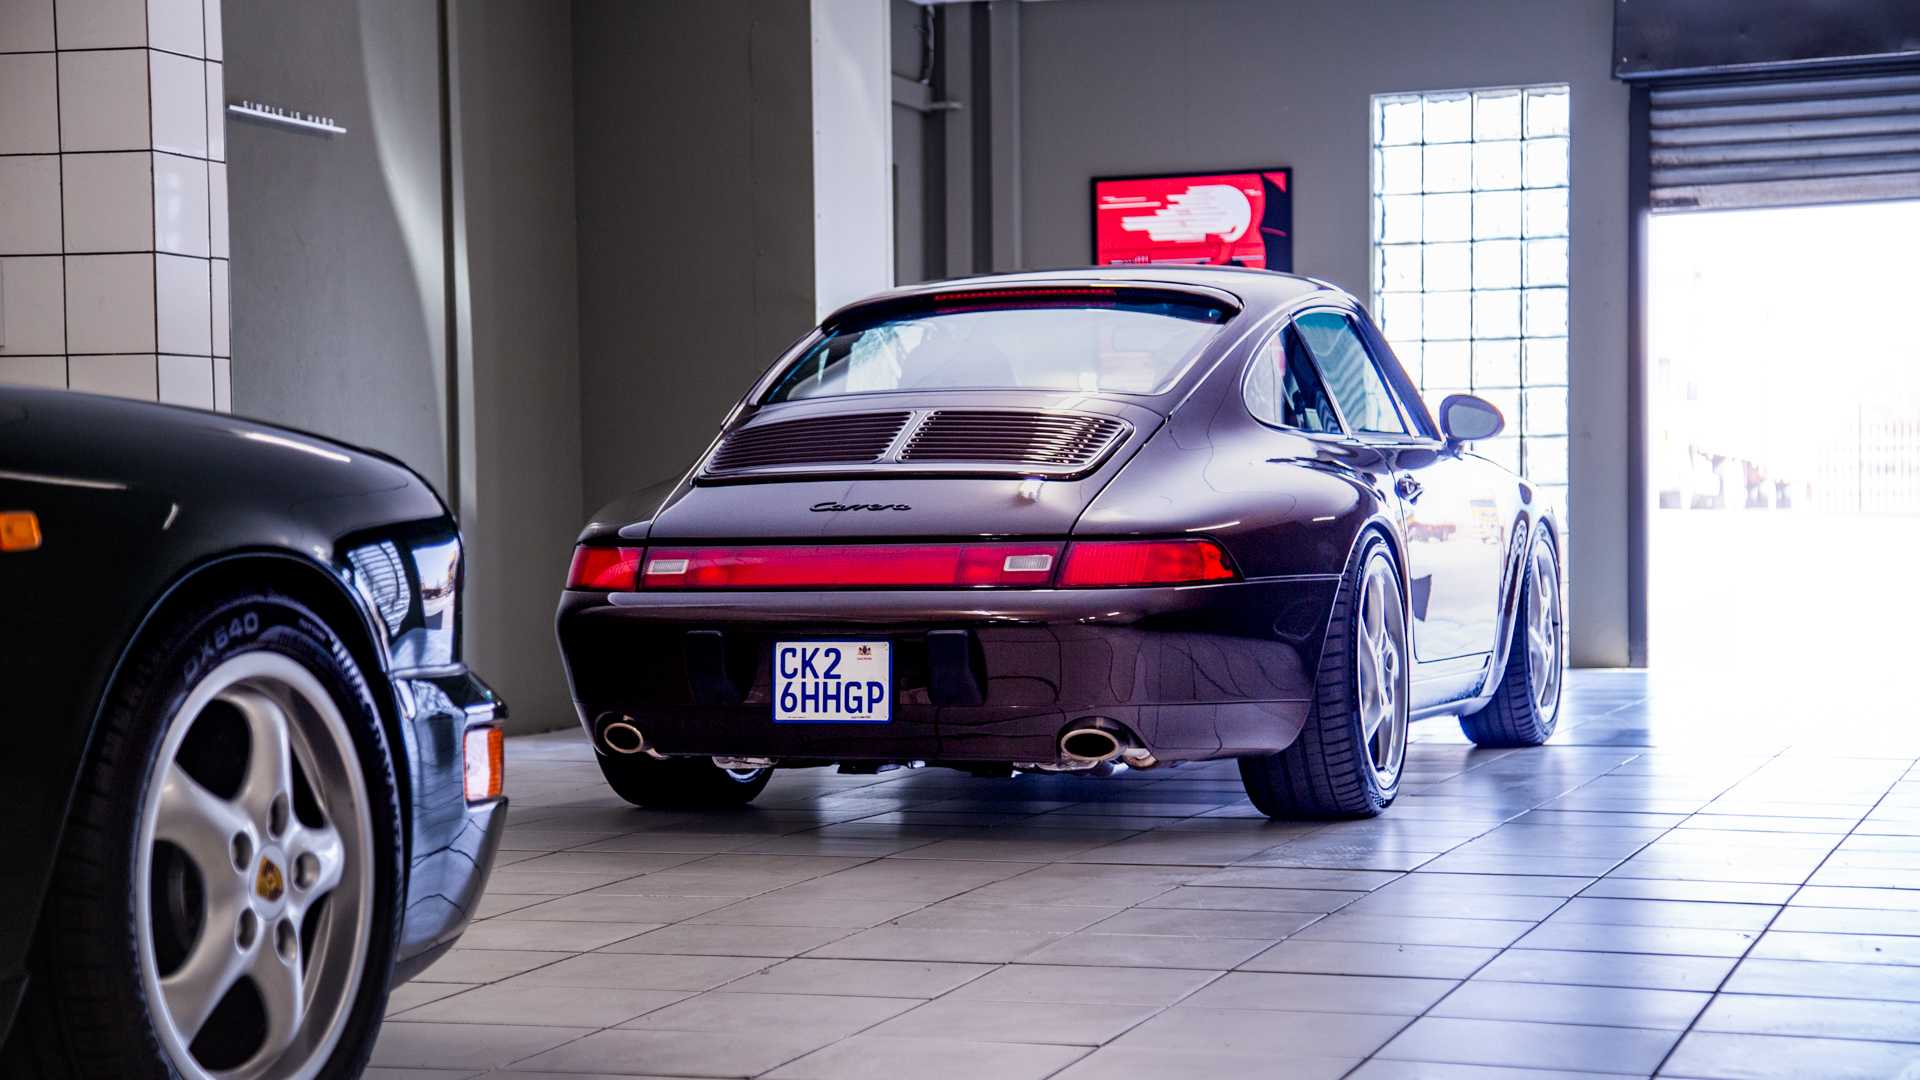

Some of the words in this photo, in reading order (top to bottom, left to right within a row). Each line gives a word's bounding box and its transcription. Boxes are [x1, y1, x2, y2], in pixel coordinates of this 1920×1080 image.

[242, 100, 284, 119] SIMPLE
[809, 501, 912, 512] Carrera
[780, 647, 842, 680] CK2
[780, 681, 885, 714] 6HHGP
